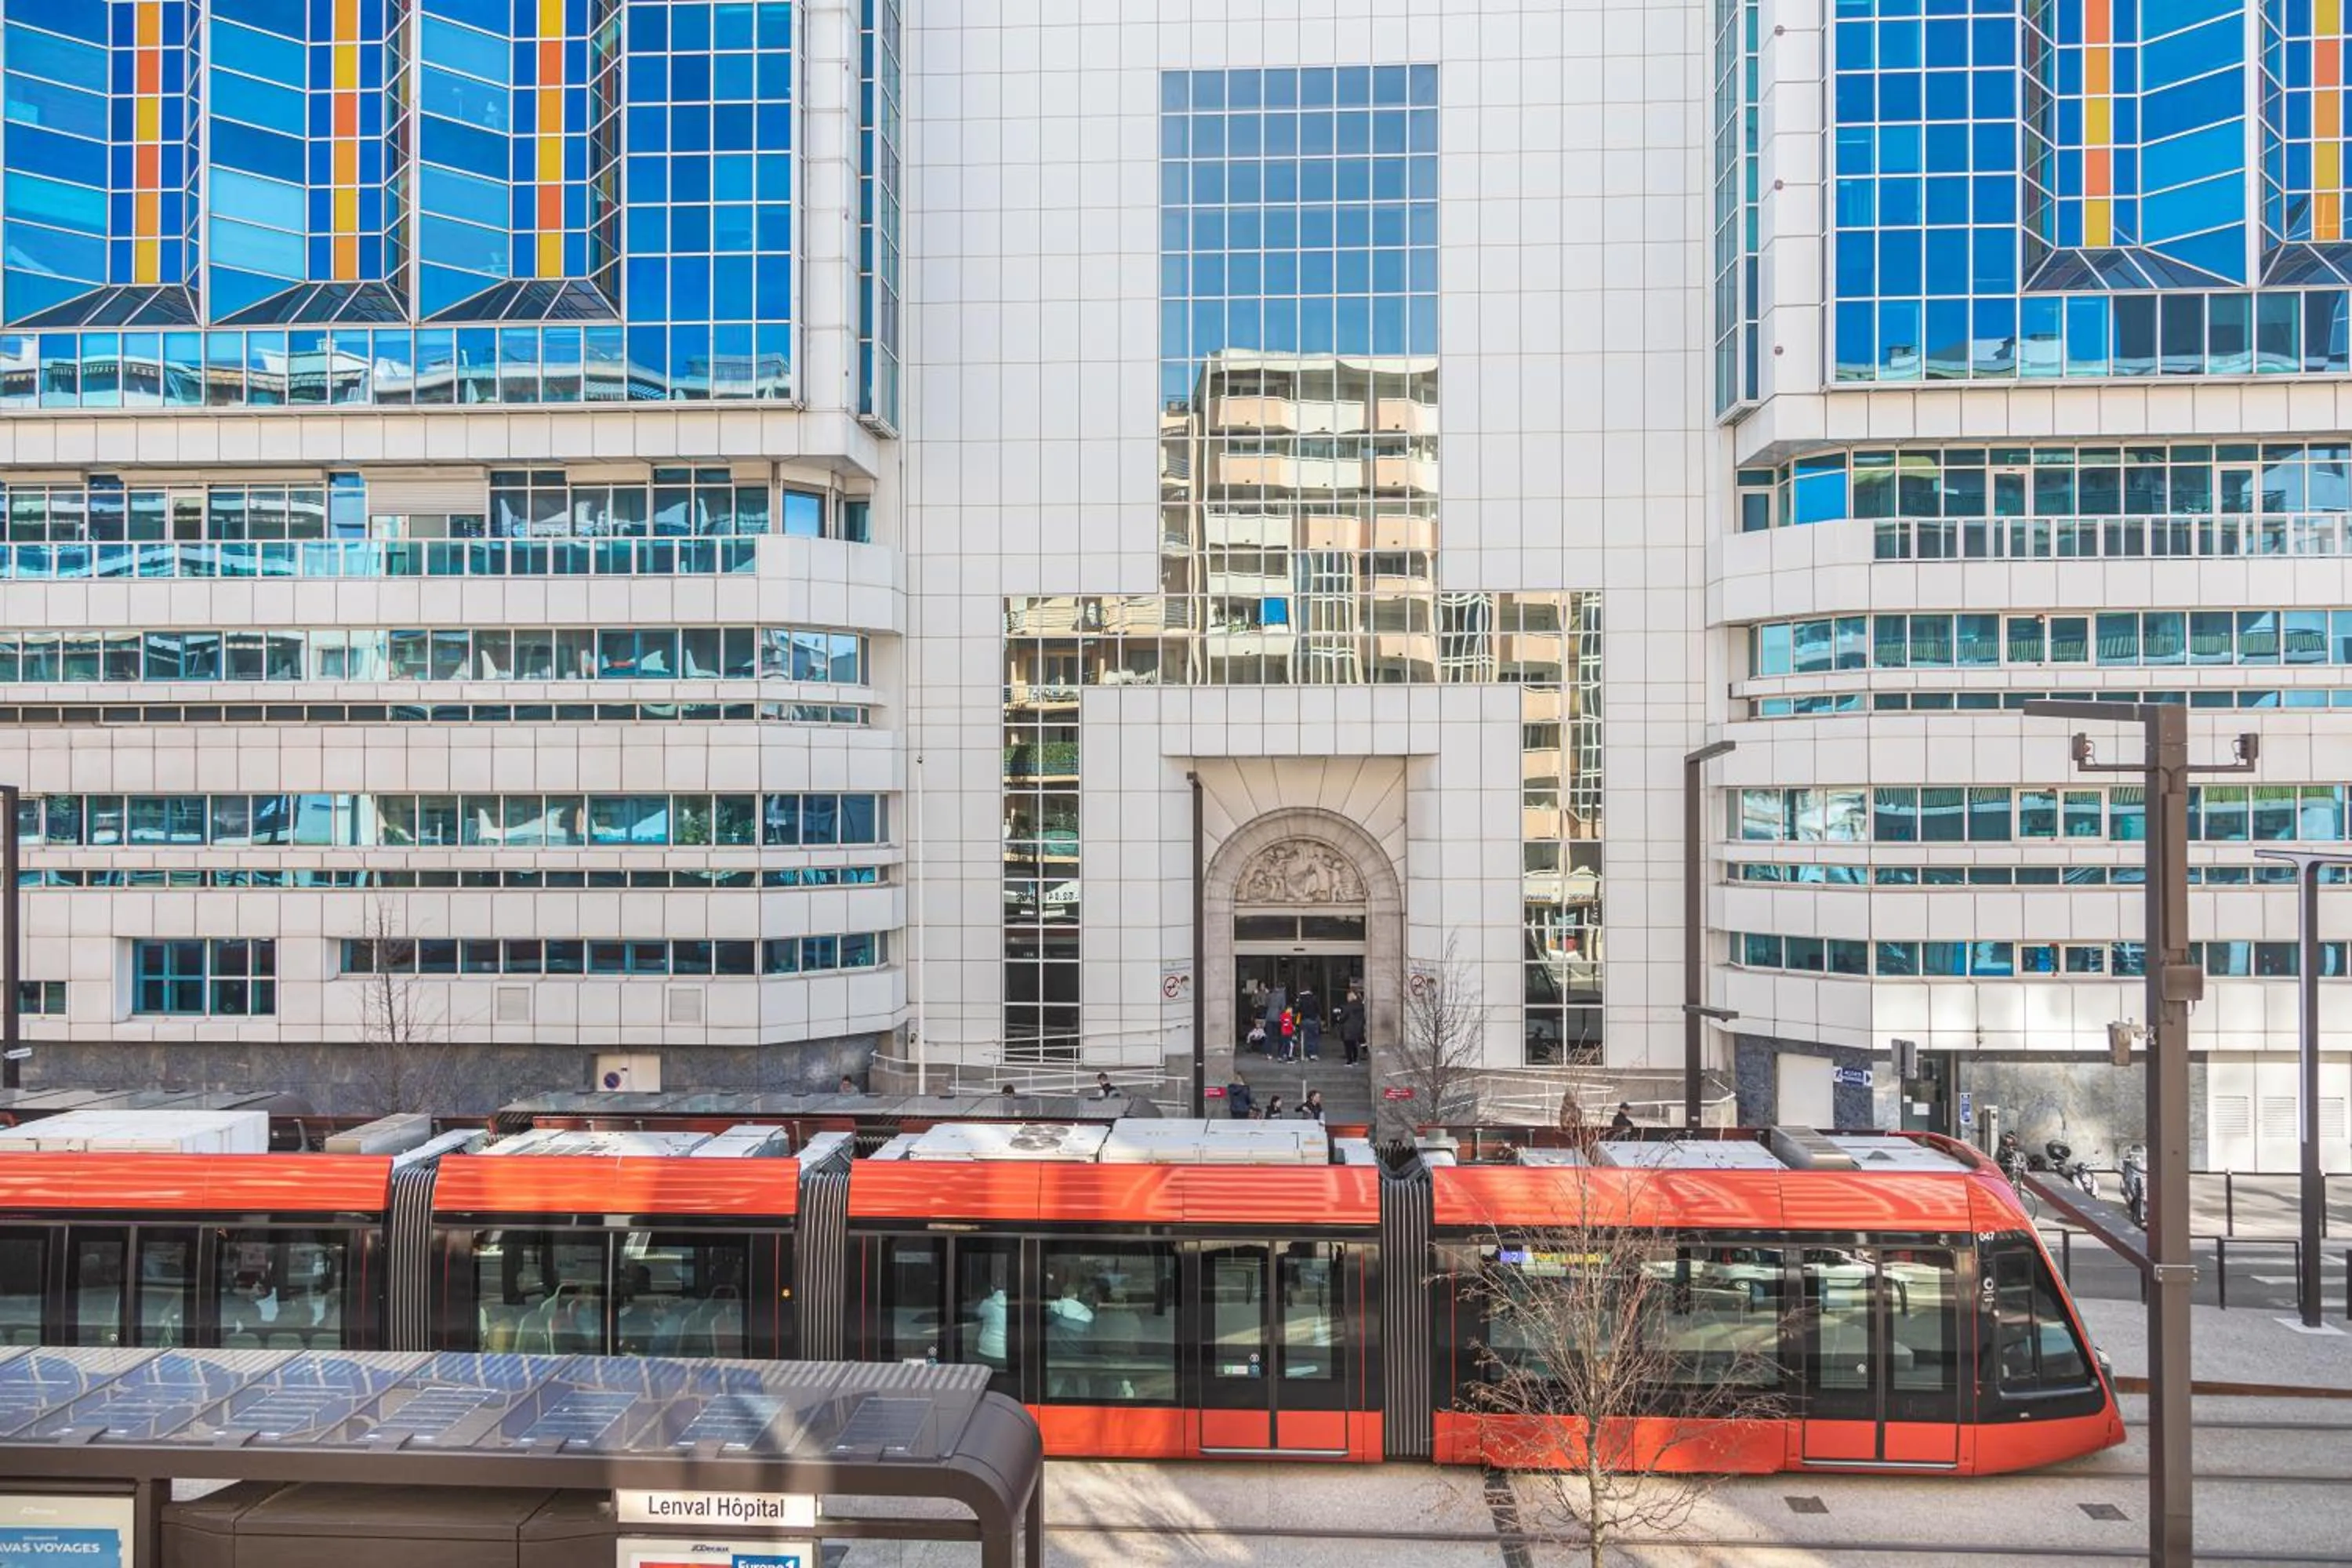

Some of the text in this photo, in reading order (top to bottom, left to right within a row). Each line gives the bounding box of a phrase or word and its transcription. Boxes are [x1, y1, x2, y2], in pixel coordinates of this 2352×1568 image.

[648, 1496, 785, 1521] Lenval Hôpital
[33, 1543, 100, 1553] VOYAGES
